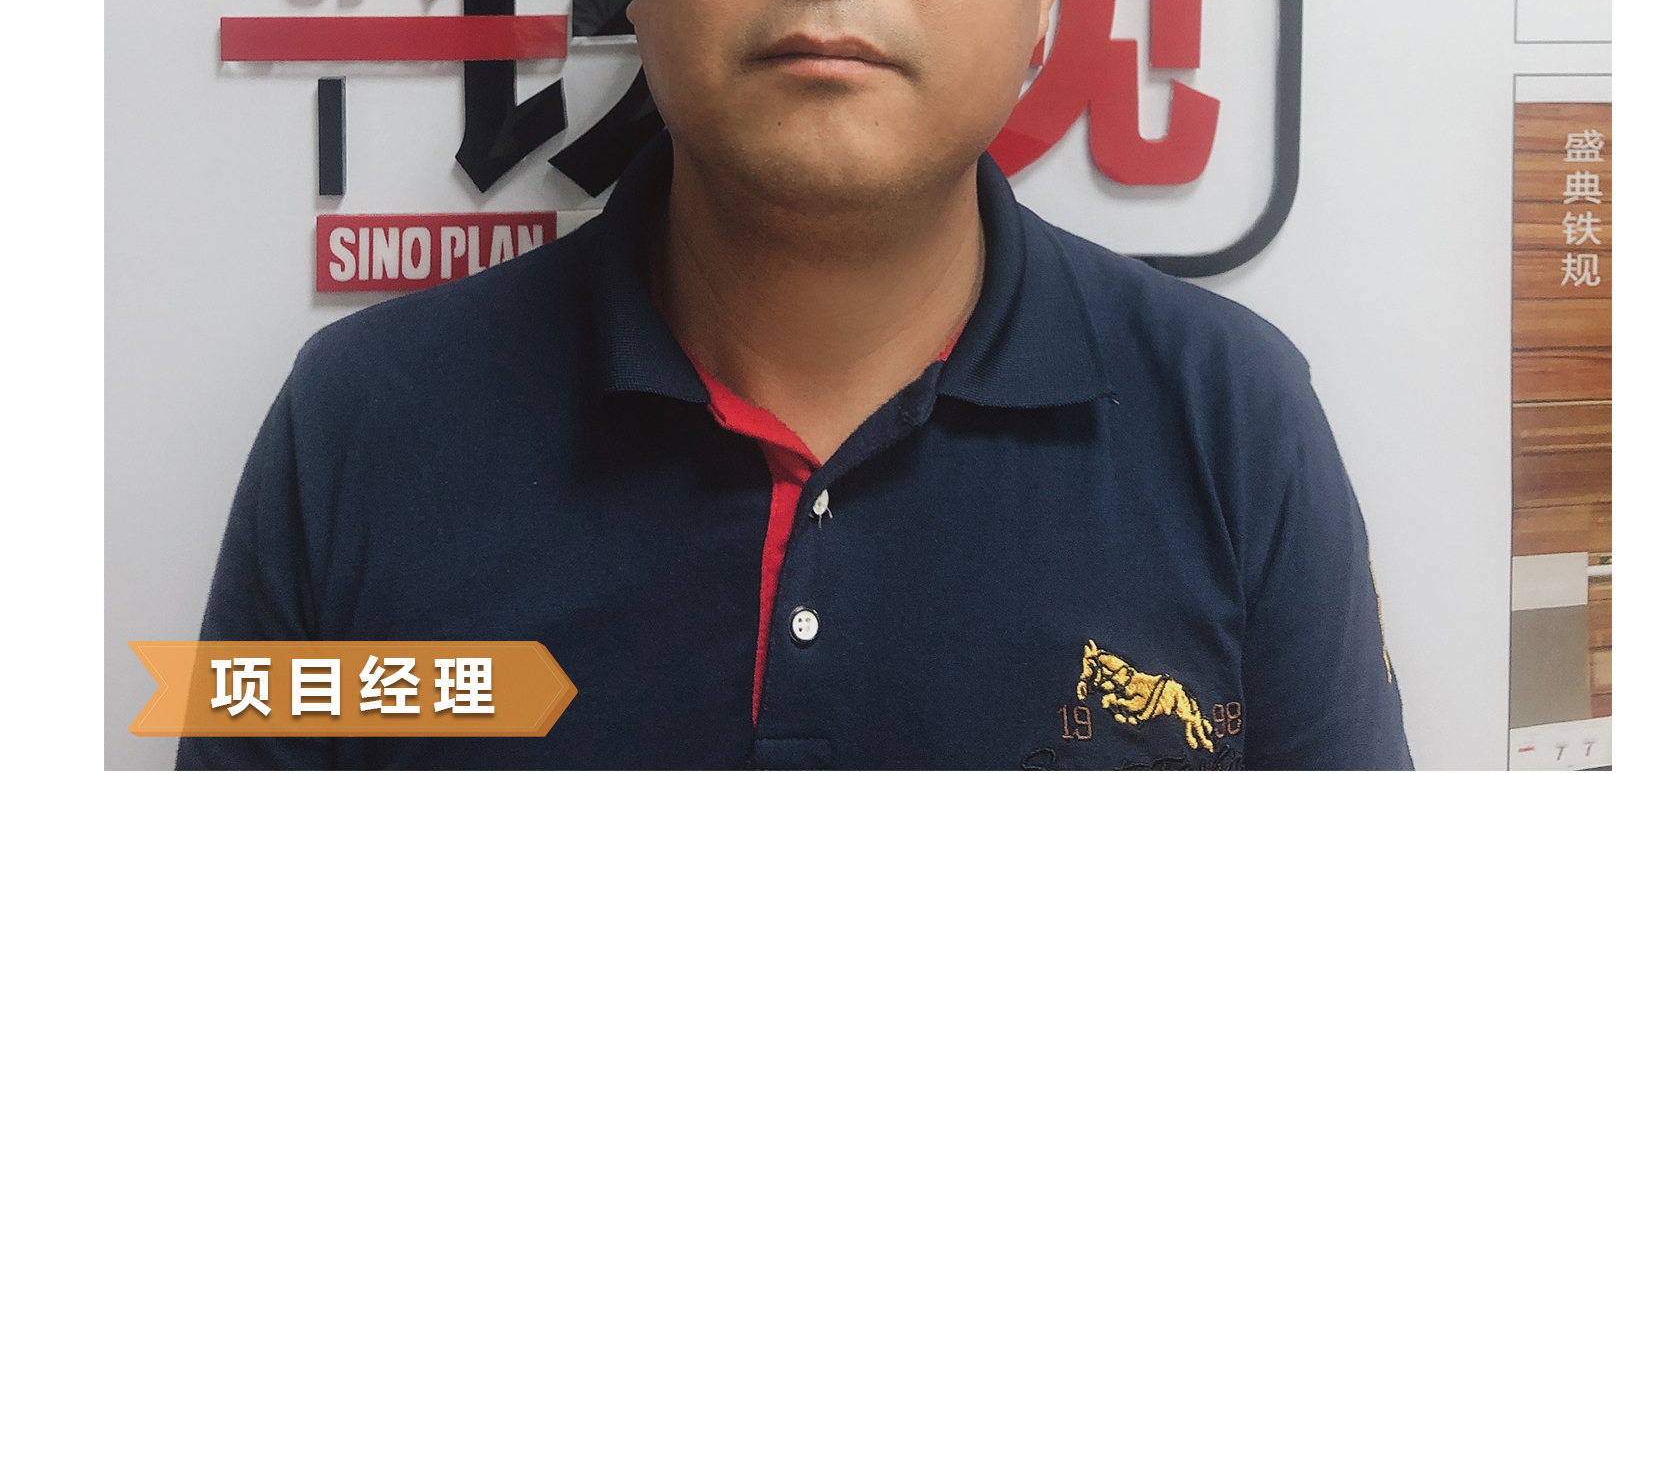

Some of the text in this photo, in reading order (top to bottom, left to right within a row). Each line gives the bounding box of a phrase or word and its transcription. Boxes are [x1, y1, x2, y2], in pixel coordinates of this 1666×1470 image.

[1560, 130, 1605, 289] 盛典铁规
[329, 226, 432, 282] SINO
[1057, 701, 1243, 740] 19 98
